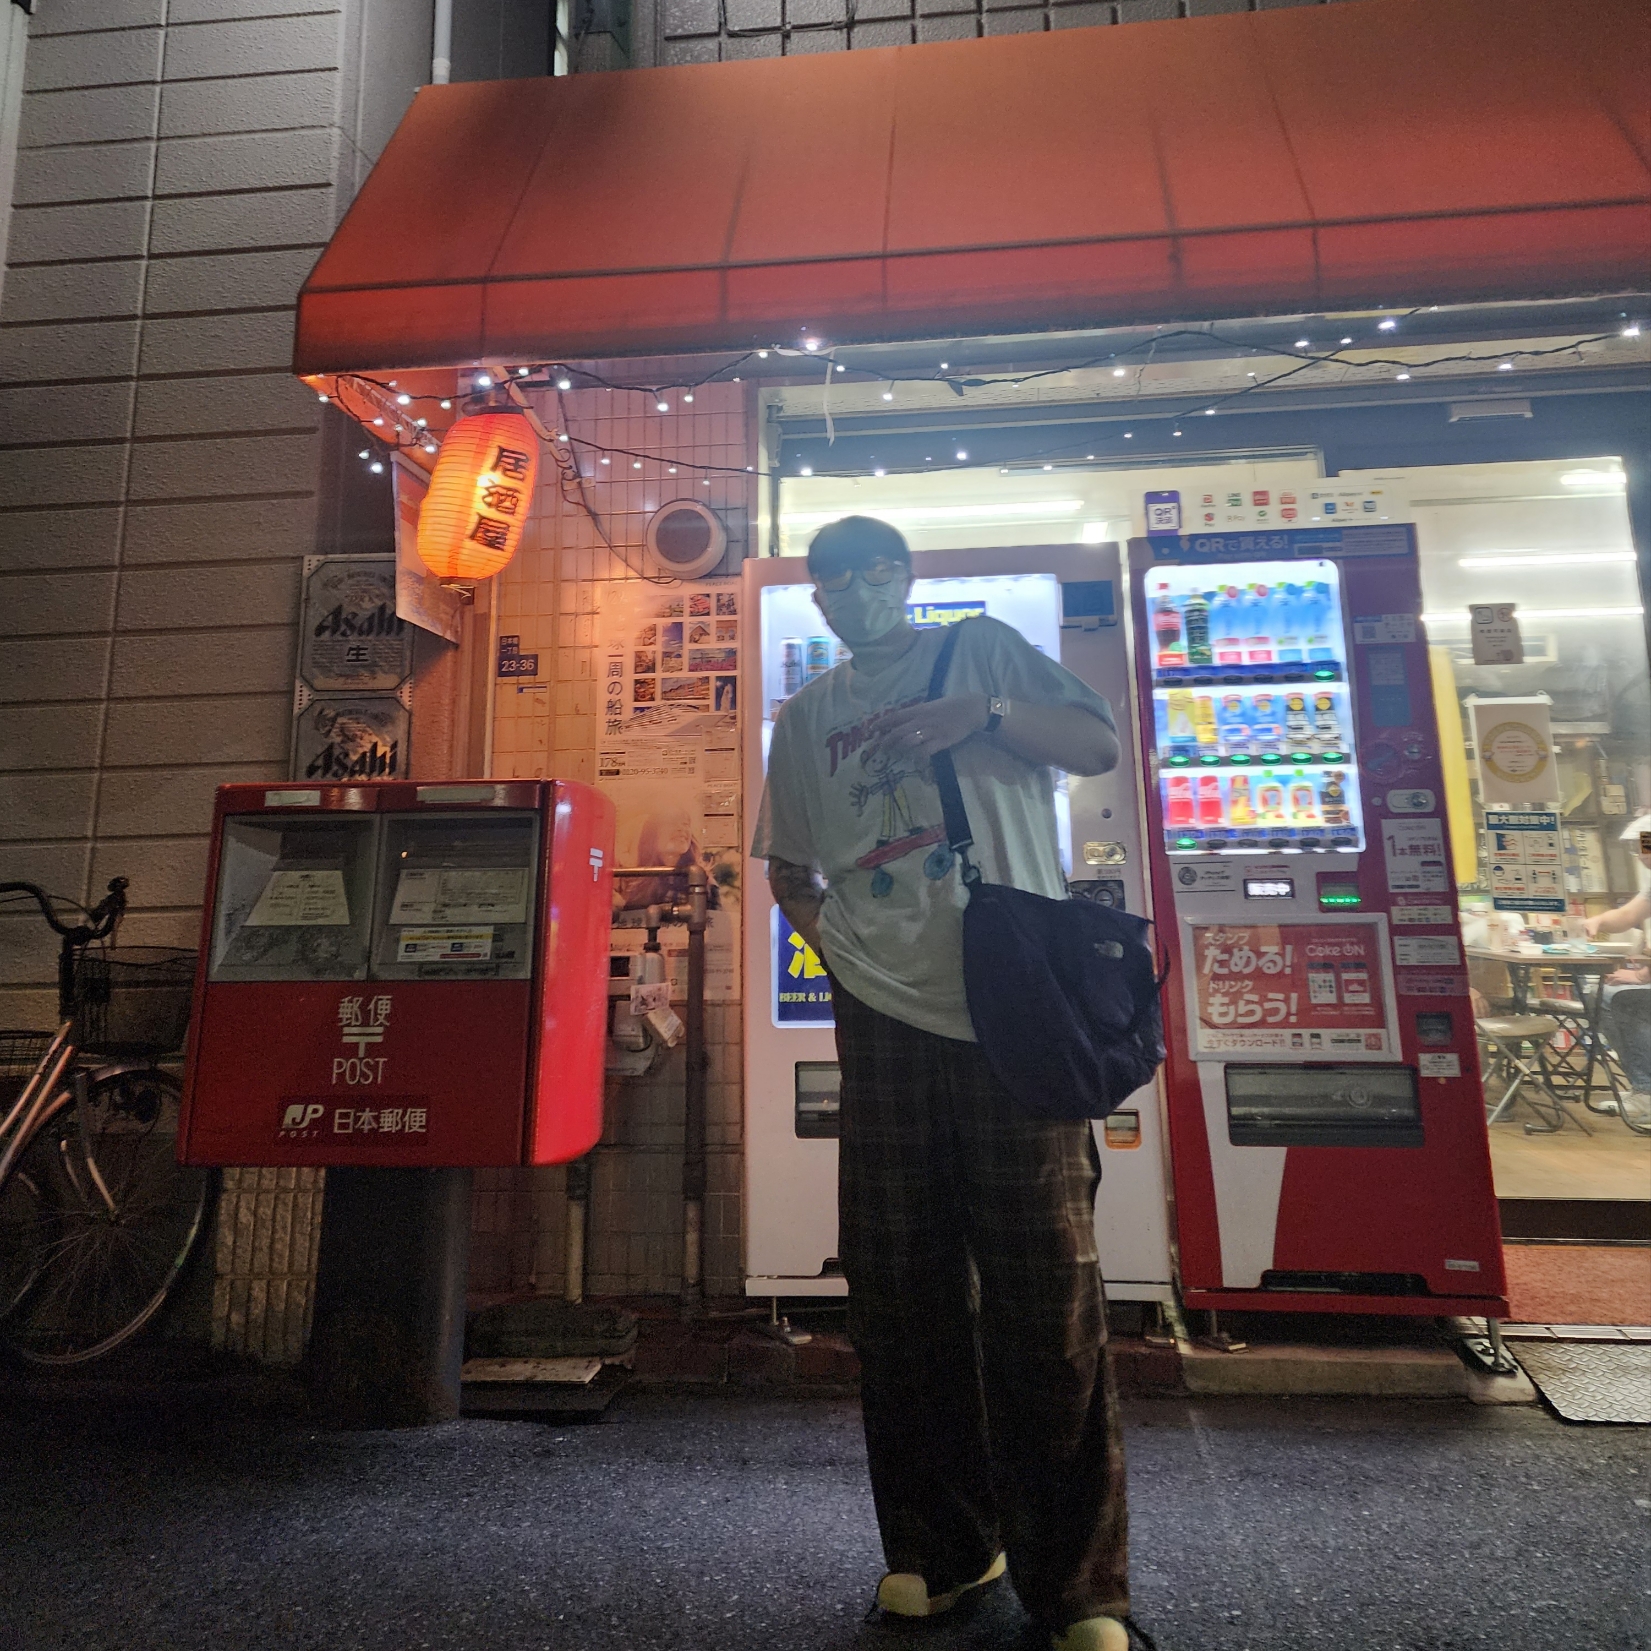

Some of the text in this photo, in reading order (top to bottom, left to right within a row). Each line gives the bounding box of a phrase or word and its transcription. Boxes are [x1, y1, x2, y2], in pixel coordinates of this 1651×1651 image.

[468, 445, 529, 551] 居酒屋
[314, 602, 405, 638] Asahi
[345, 645, 370, 662] 生
[501, 659, 535, 672] 23-36
[305, 739, 398, 778] Asahi
[1204, 933, 1250, 945] スタンプ
[1305, 944, 1340, 957] Coke
[1202, 944, 1293, 975] ためる!
[779, 993, 806, 1002] BEER
[808, 992, 816, 1002] &
[1208, 979, 1255, 993] ドリンク
[338, 995, 393, 1027] 郵便
[1207, 992, 1299, 1024] もらう!
[331, 1058, 388, 1085] POST
[278, 1130, 320, 1138] POST
[333, 1107, 428, 1134] 日本郵便
